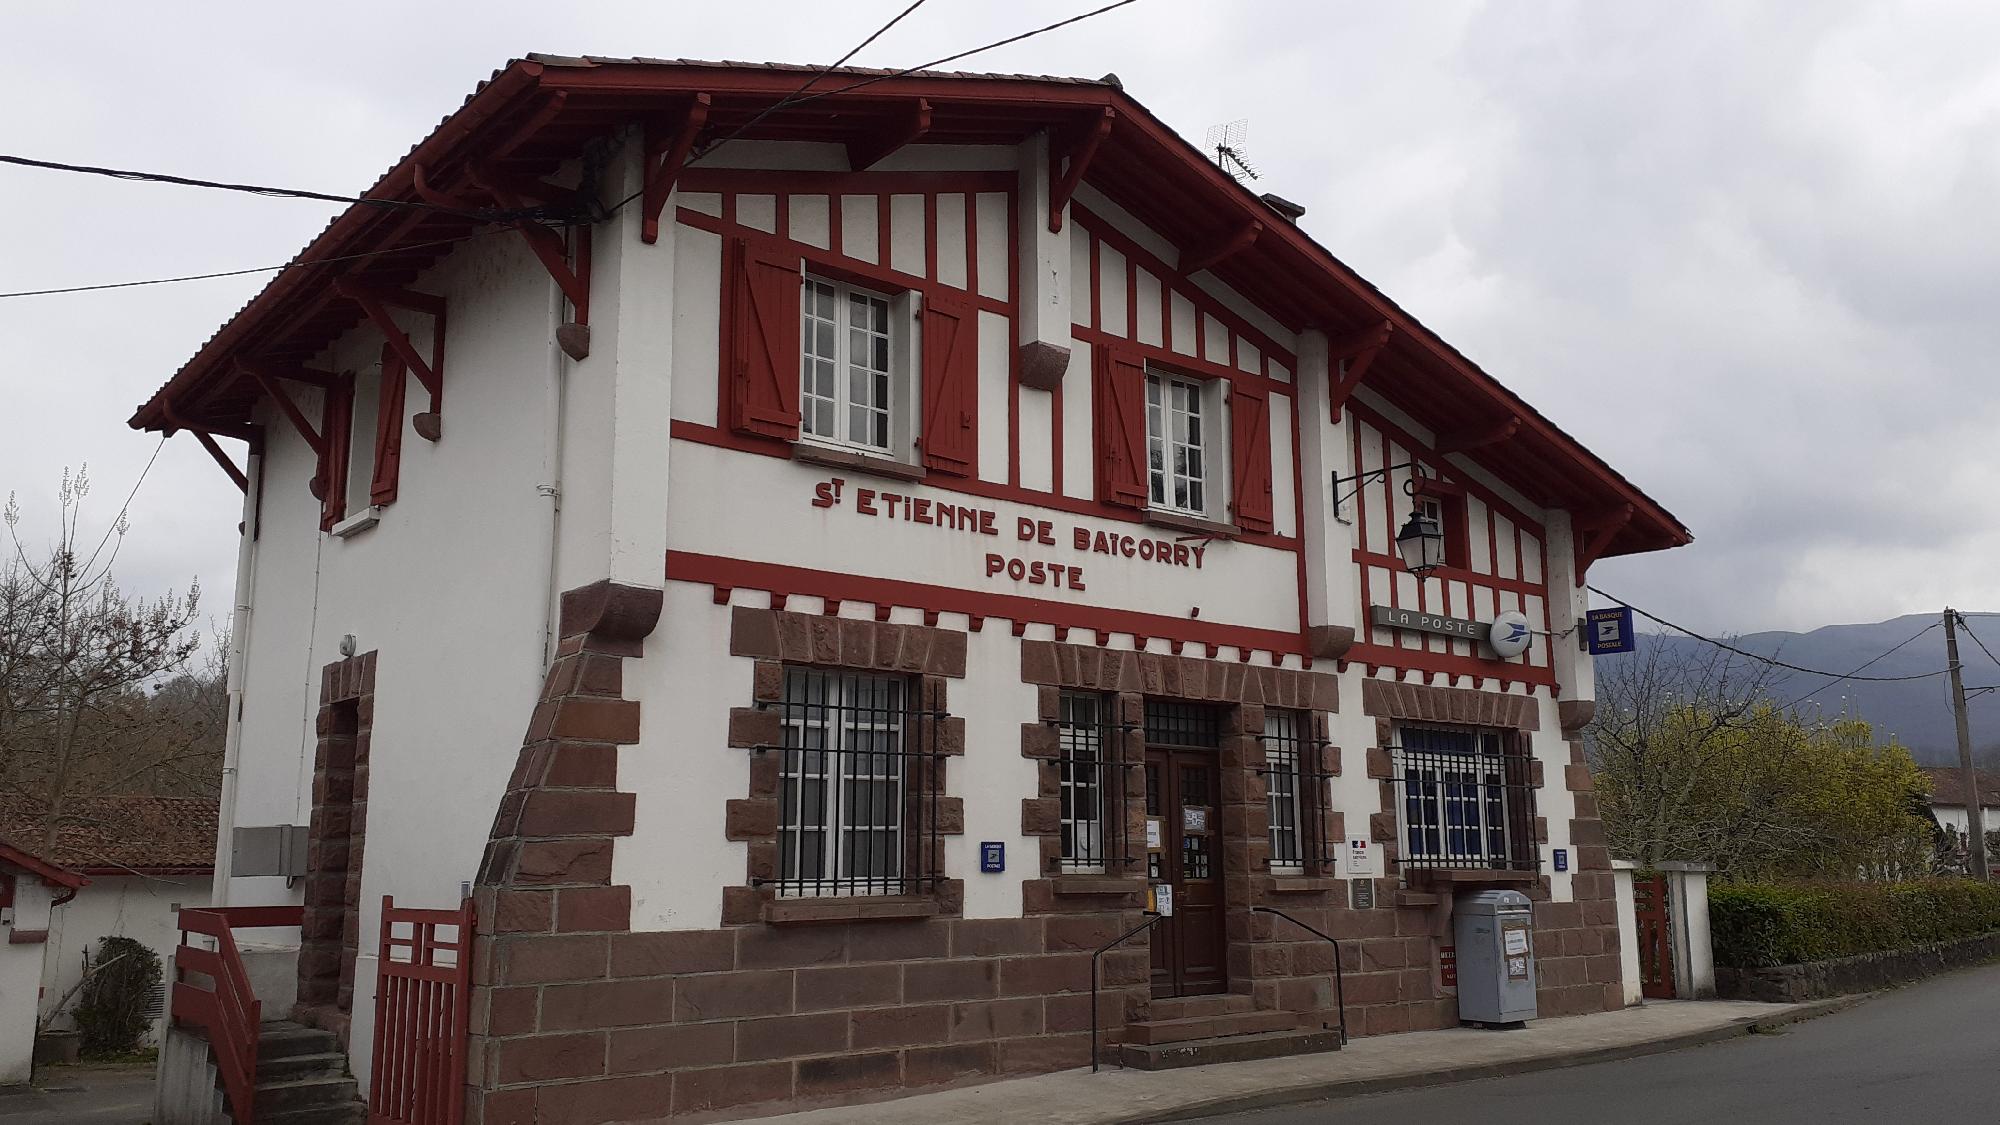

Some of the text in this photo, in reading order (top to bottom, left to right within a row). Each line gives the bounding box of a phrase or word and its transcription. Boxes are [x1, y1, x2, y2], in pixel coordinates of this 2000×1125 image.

[857, 488, 999, 535] ETIENNE
[1017, 516, 1056, 546] DE
[1073, 526, 1206, 569] BAÏGORRY
[985, 553, 1087, 591] POSTE
[1388, 610, 1476, 635] LA POSTE
